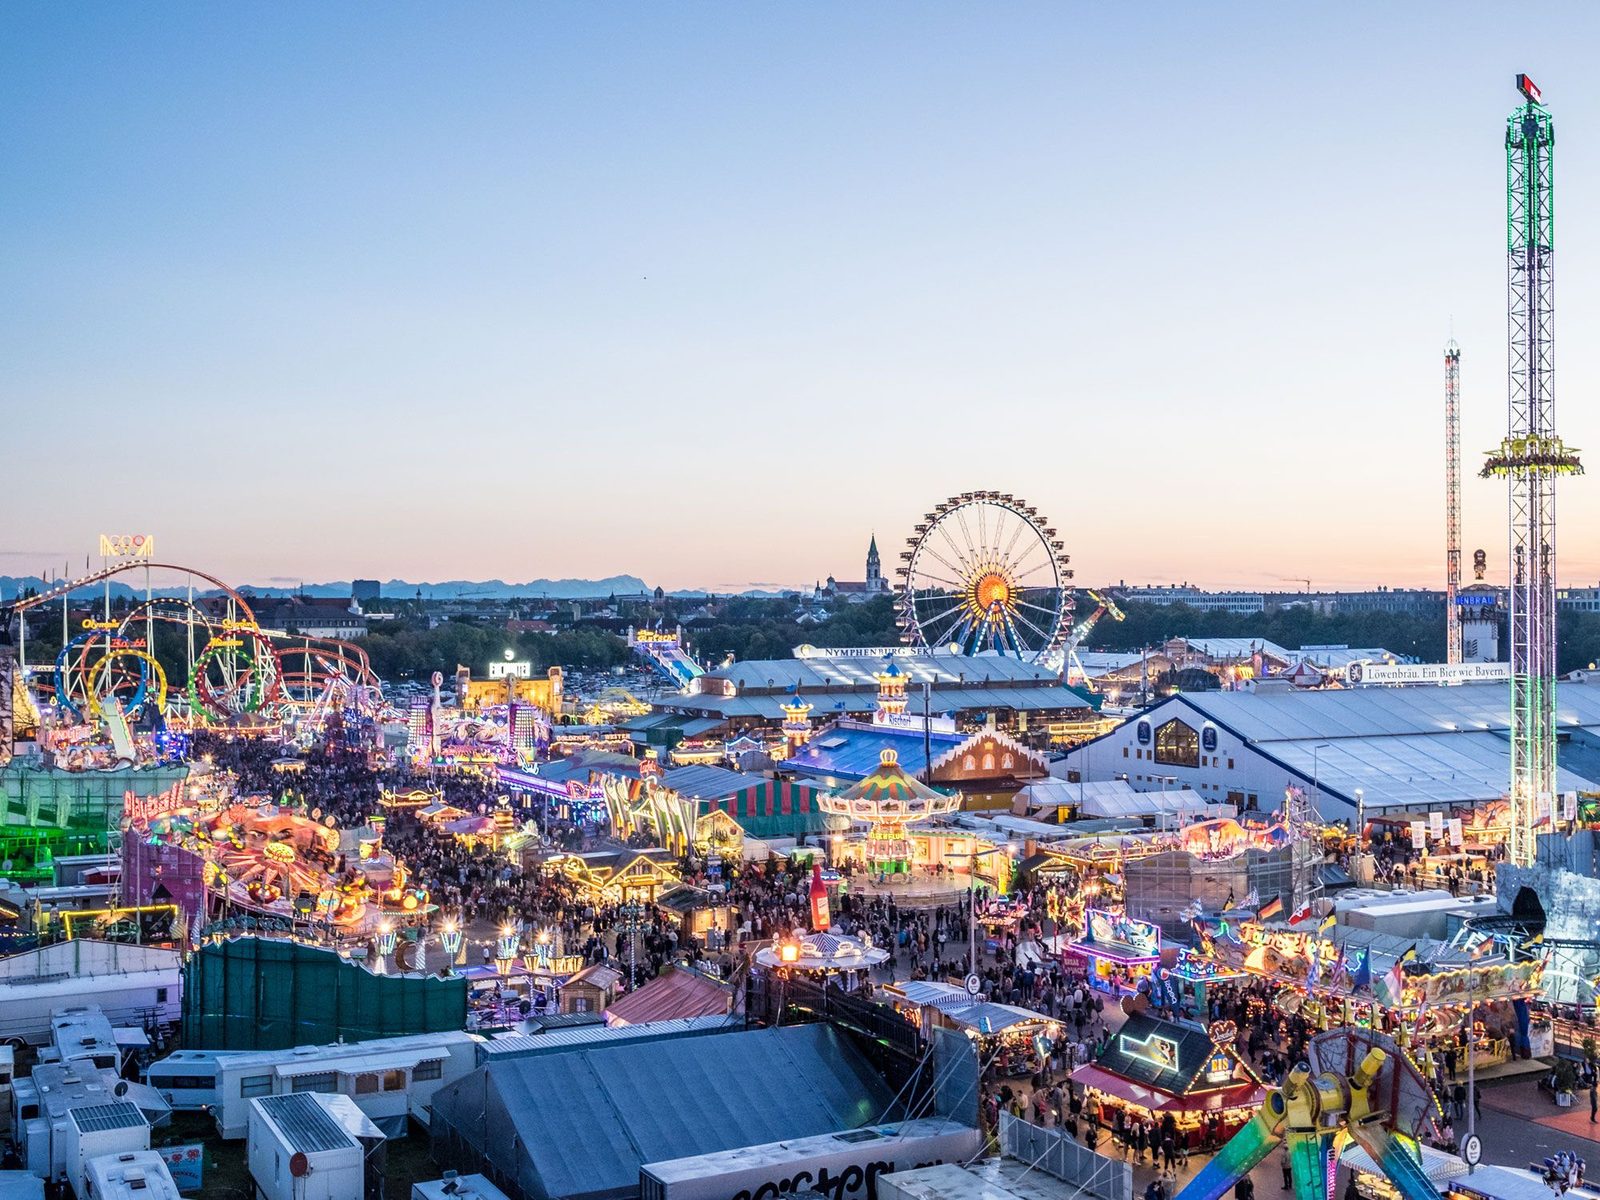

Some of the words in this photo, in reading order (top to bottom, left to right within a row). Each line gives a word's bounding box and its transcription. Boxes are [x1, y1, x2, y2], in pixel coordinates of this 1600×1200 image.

[825, 647, 905, 657] NYMPHENBURG
[911, 646, 936, 656] SEKT
[1368, 666, 1420, 680] Löwenbräu.
[1422, 666, 1437, 679] Ein
[1439, 665, 1457, 678] Bier
[1459, 666, 1473, 677] wie
[1475, 665, 1506, 679] Bayern.
[1211, 1057, 1229, 1073] EIS
